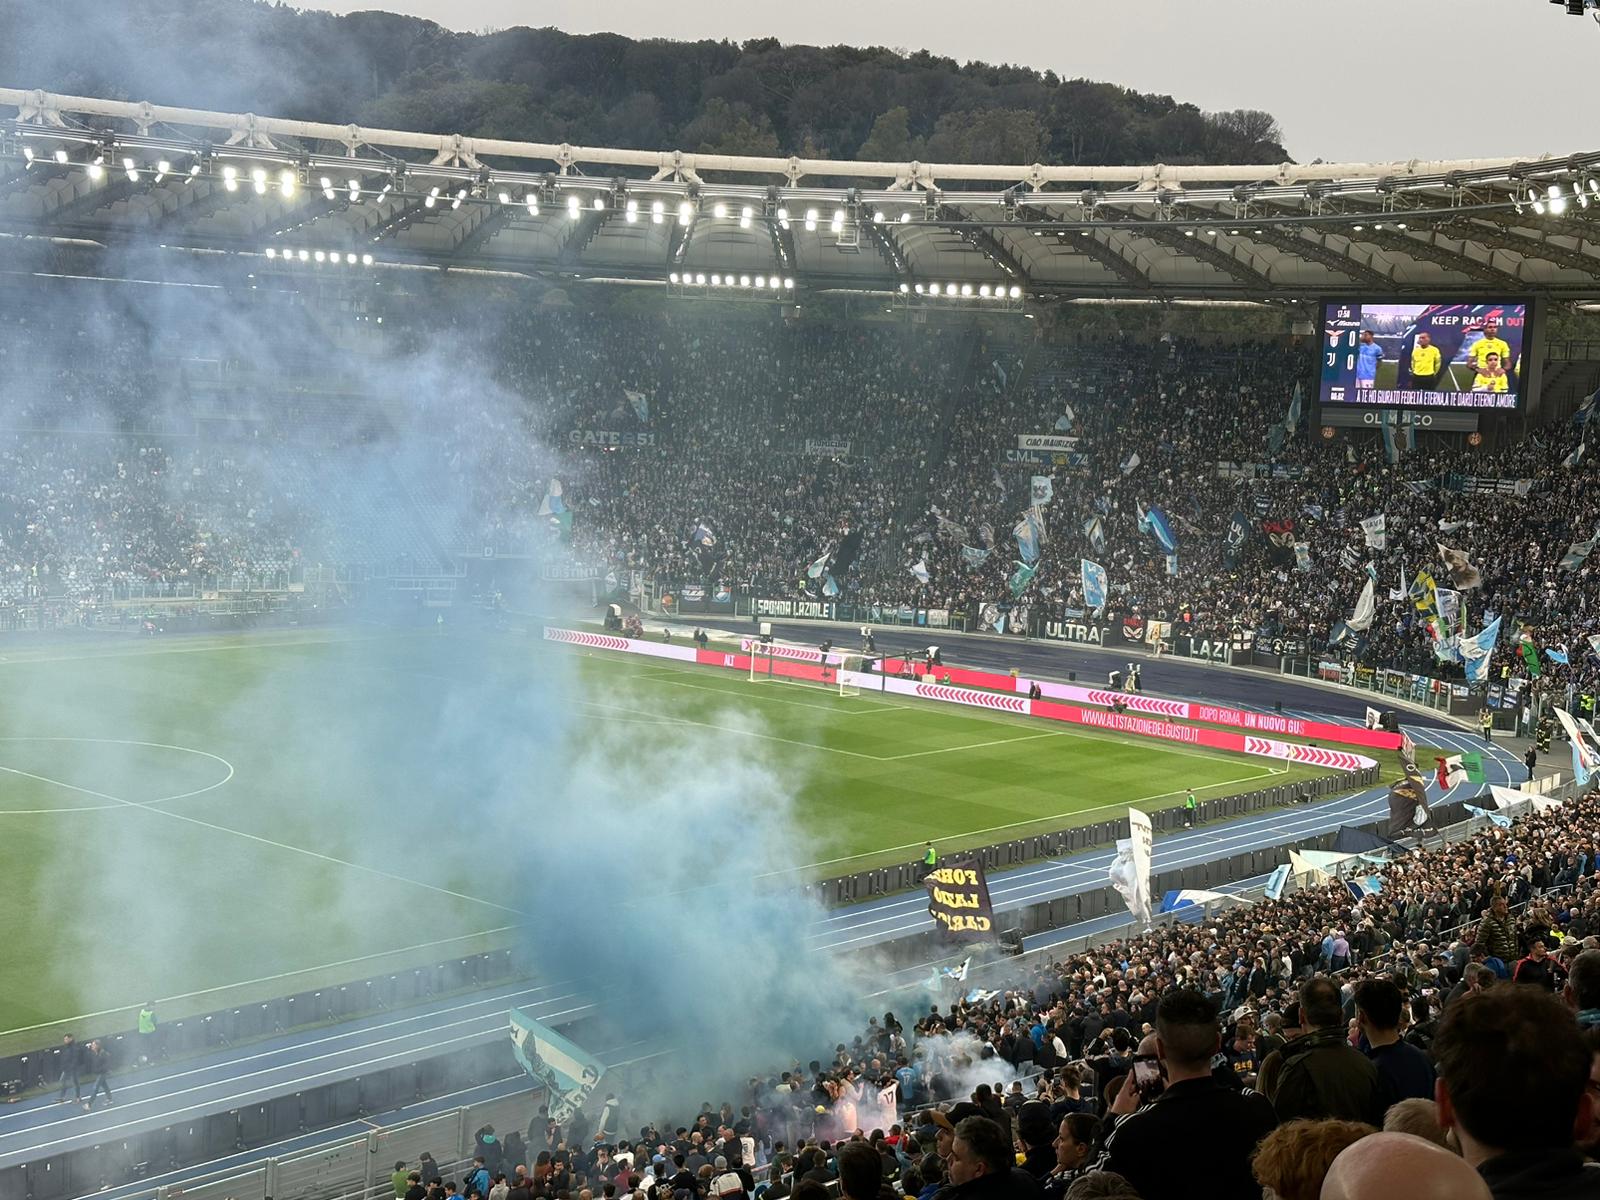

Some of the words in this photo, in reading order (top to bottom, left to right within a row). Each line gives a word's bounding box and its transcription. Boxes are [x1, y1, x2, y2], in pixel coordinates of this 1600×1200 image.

[1431, 316, 1459, 325] KEEP
[1462, 316, 1503, 326] RACM
[1349, 330, 1356, 347] 0
[1347, 354, 1354, 370] 0
[1496, 393, 1516, 408] AMORE
[1363, 412, 1433, 426] OLMPICO
[568, 429, 621, 446] GATE
[637, 432, 656, 446] 51
[484, 547, 493, 557] D
[1081, 709, 1199, 742] WWW.ALTSTAZIONEDELGUSTO.IT
[1199, 706, 1219, 721] DOPO
[1244, 712, 1257, 728] UN
[1257, 715, 1286, 732] NUOVO
[883, 1091, 894, 1104] 17
